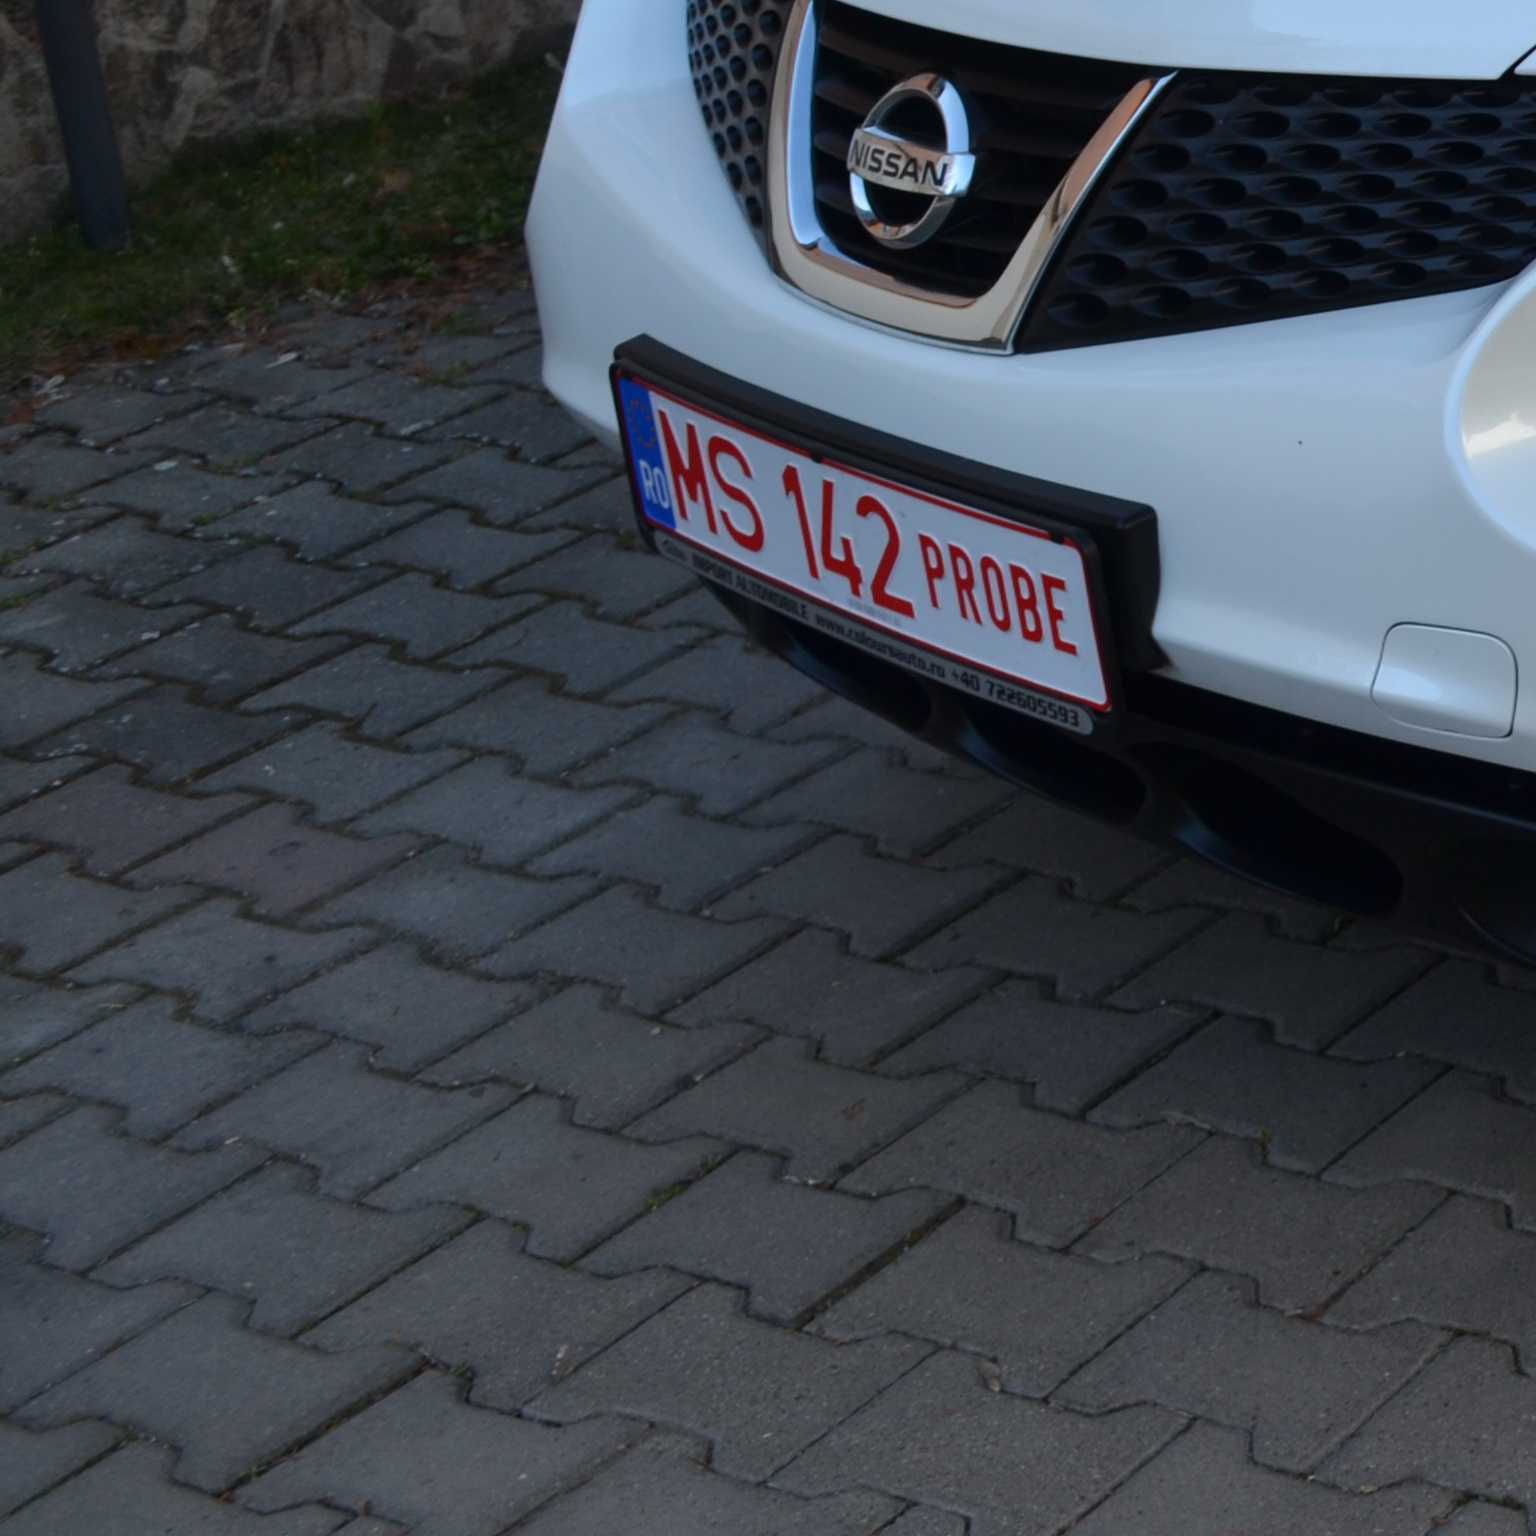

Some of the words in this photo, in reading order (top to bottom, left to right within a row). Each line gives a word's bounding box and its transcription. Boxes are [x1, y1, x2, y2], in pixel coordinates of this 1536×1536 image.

[850, 139, 949, 187] NISSAN
[639, 459, 671, 509] RO
[658, 409, 765, 553] MS
[782, 465, 915, 618] 142
[918, 533, 1079, 656] PROBE
[736, 574, 809, 621] AUTOMOBILE
[951, 670, 981, 693] +40
[986, 680, 1080, 727] 722605593
